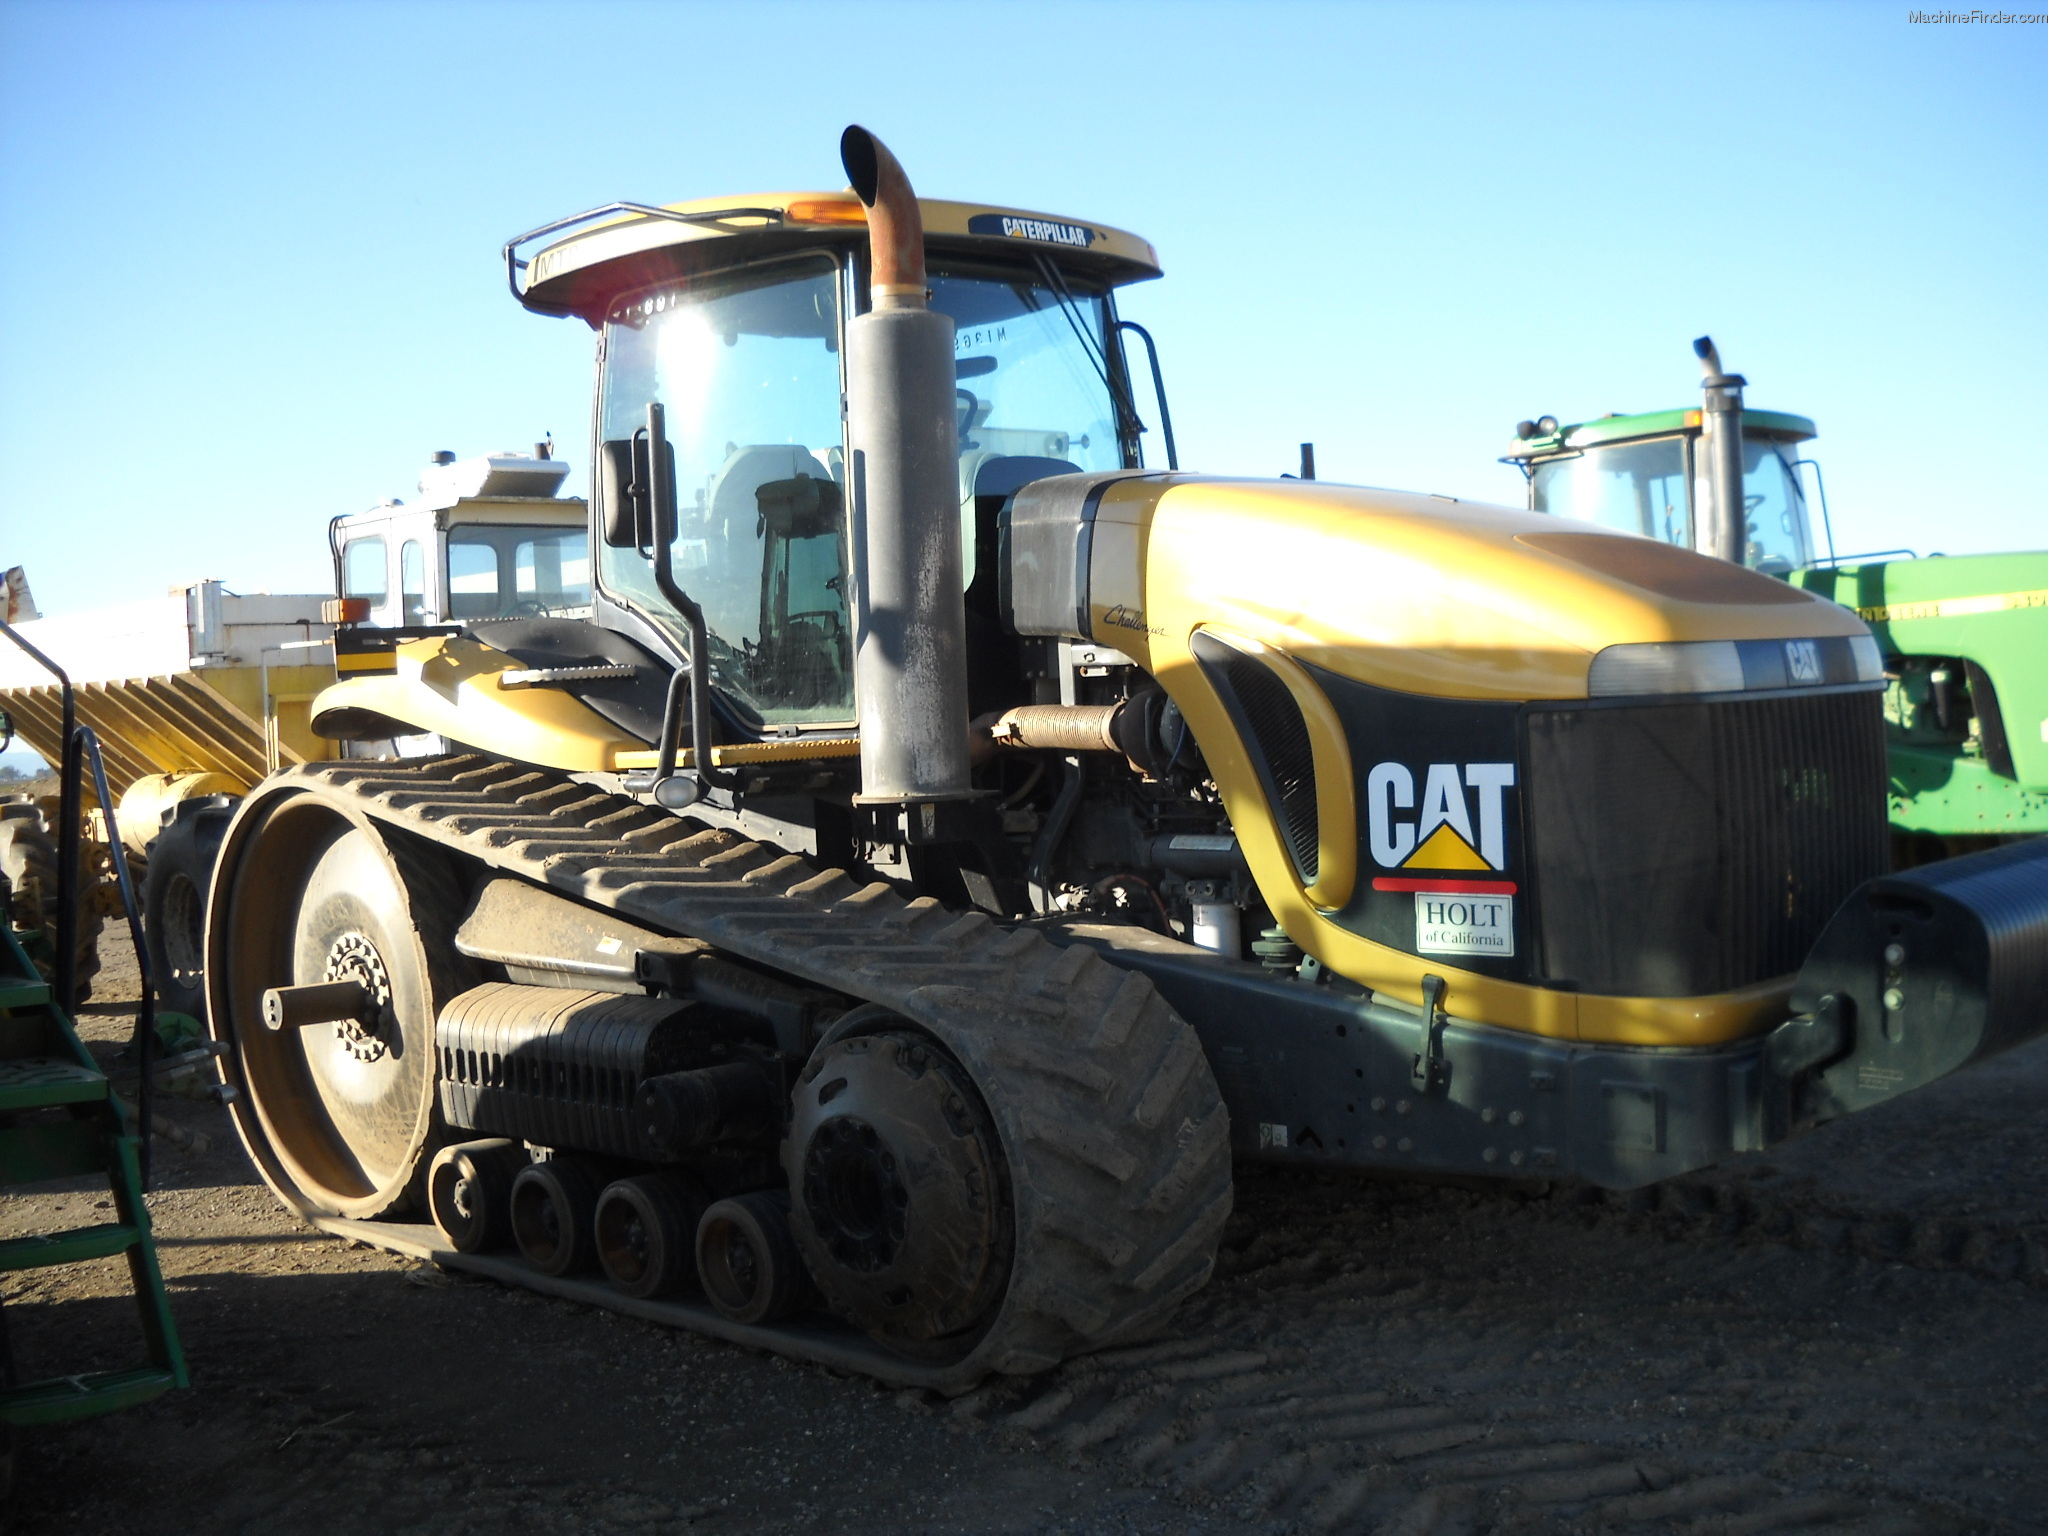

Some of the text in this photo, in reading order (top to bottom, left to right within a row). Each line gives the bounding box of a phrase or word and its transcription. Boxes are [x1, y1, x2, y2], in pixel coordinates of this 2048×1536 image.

[1002, 217, 1087, 247] CATERPILLAR
[1104, 604, 1171, 641] Challenger
[1785, 641, 1823, 684] CAT
[1368, 761, 1514, 871] CAT
[1426, 902, 1503, 927] HOLT
[1425, 931, 1504, 946] of California
